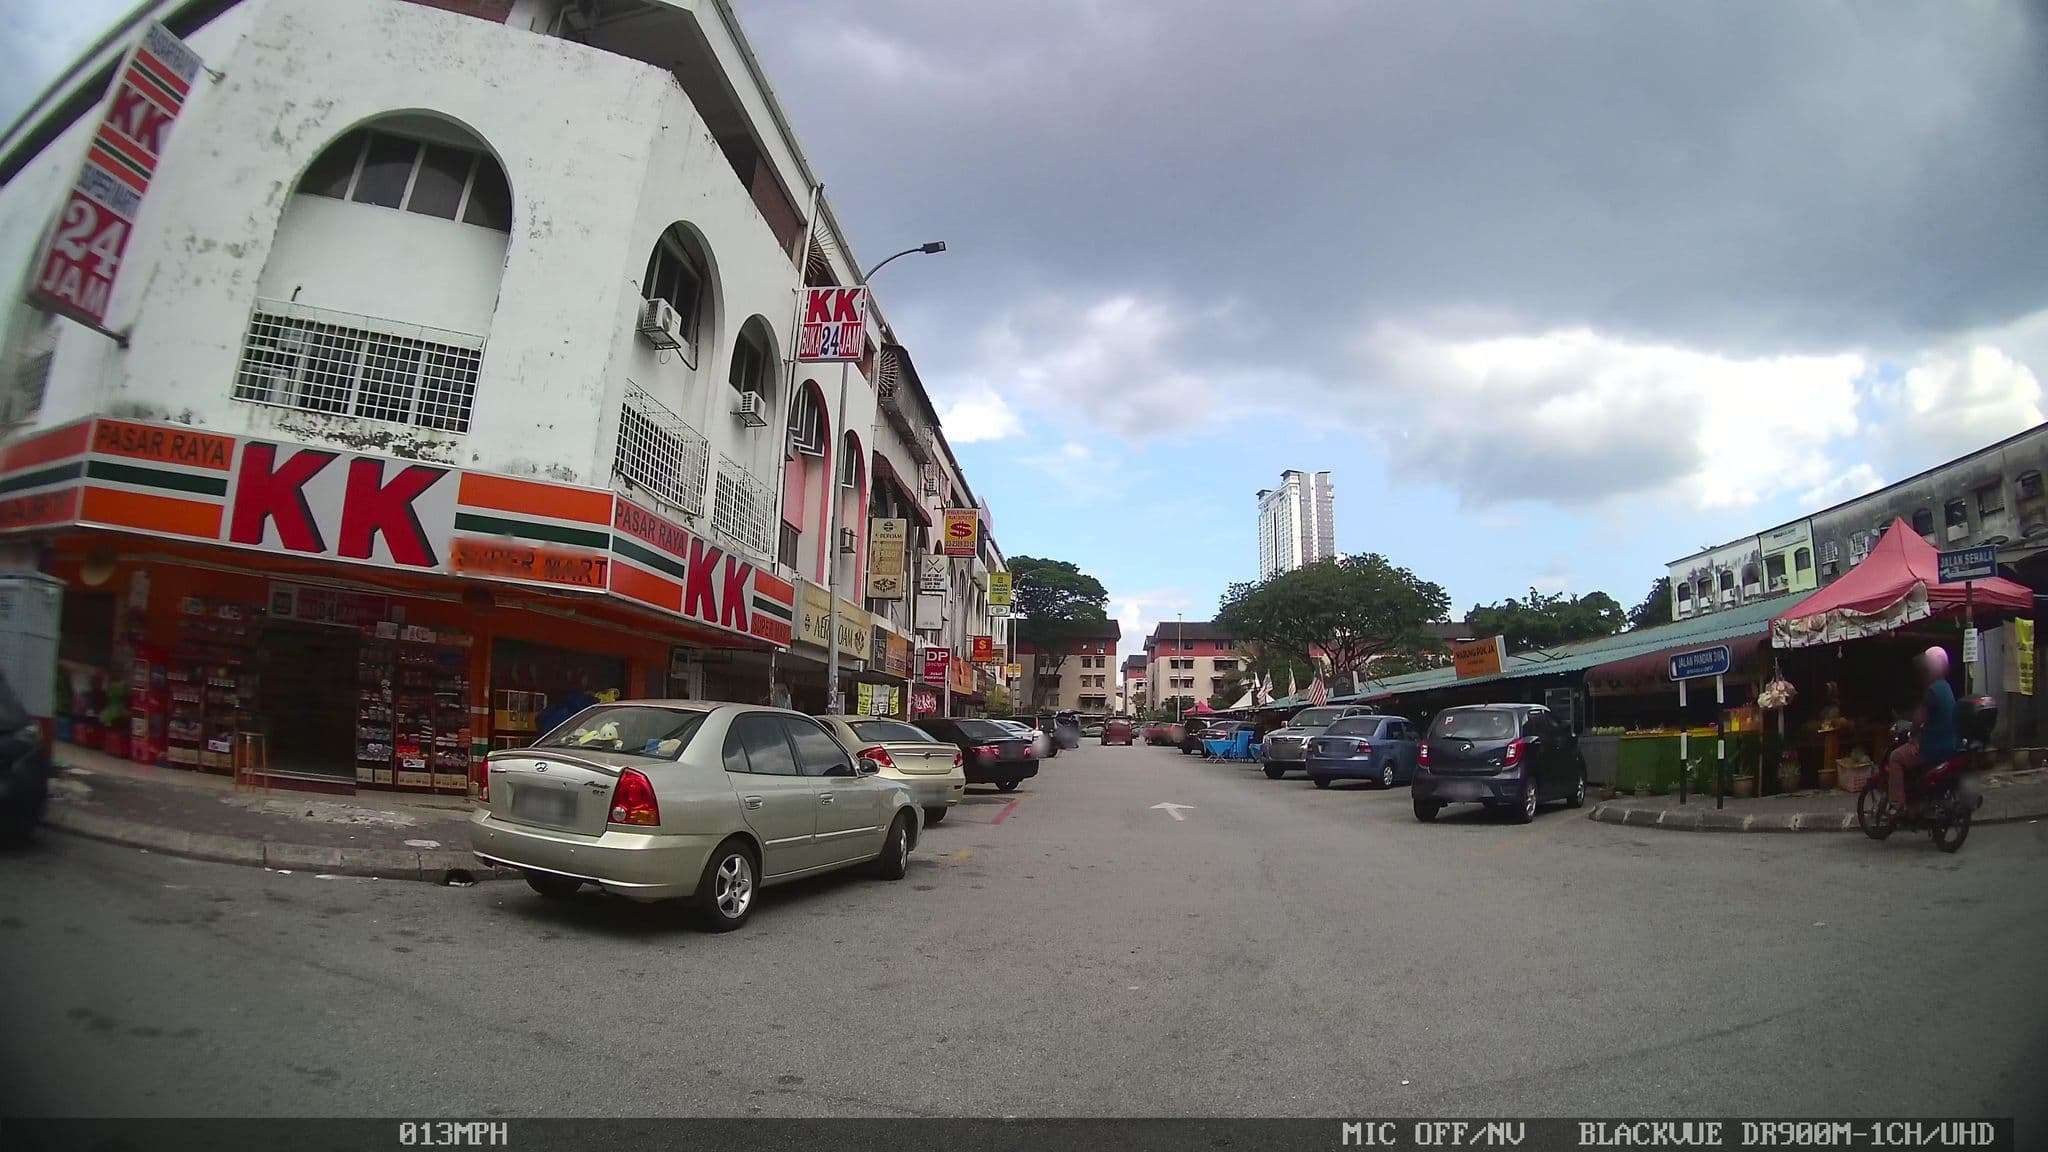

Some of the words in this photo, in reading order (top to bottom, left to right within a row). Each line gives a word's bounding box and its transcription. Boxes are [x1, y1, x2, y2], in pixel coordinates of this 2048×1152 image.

[106, 83, 174, 157] KK
[54, 199, 125, 280] 24
[42, 256, 108, 315] JAM
[807, 288, 861, 322] KK
[801, 325, 821, 355] BUKA
[820, 325, 840, 356] 24
[840, 325, 860, 355] JAM
[99, 424, 165, 458] PASAR
[170, 434, 225, 466] RAYA
[230, 440, 452, 567] KK
[615, 502, 656, 543] PASAR
[658, 523, 685, 556] RAYA
[685, 536, 754, 634] KK
[926, 651, 949, 661] DP
[1679, 655, 1693, 668] JALAN
